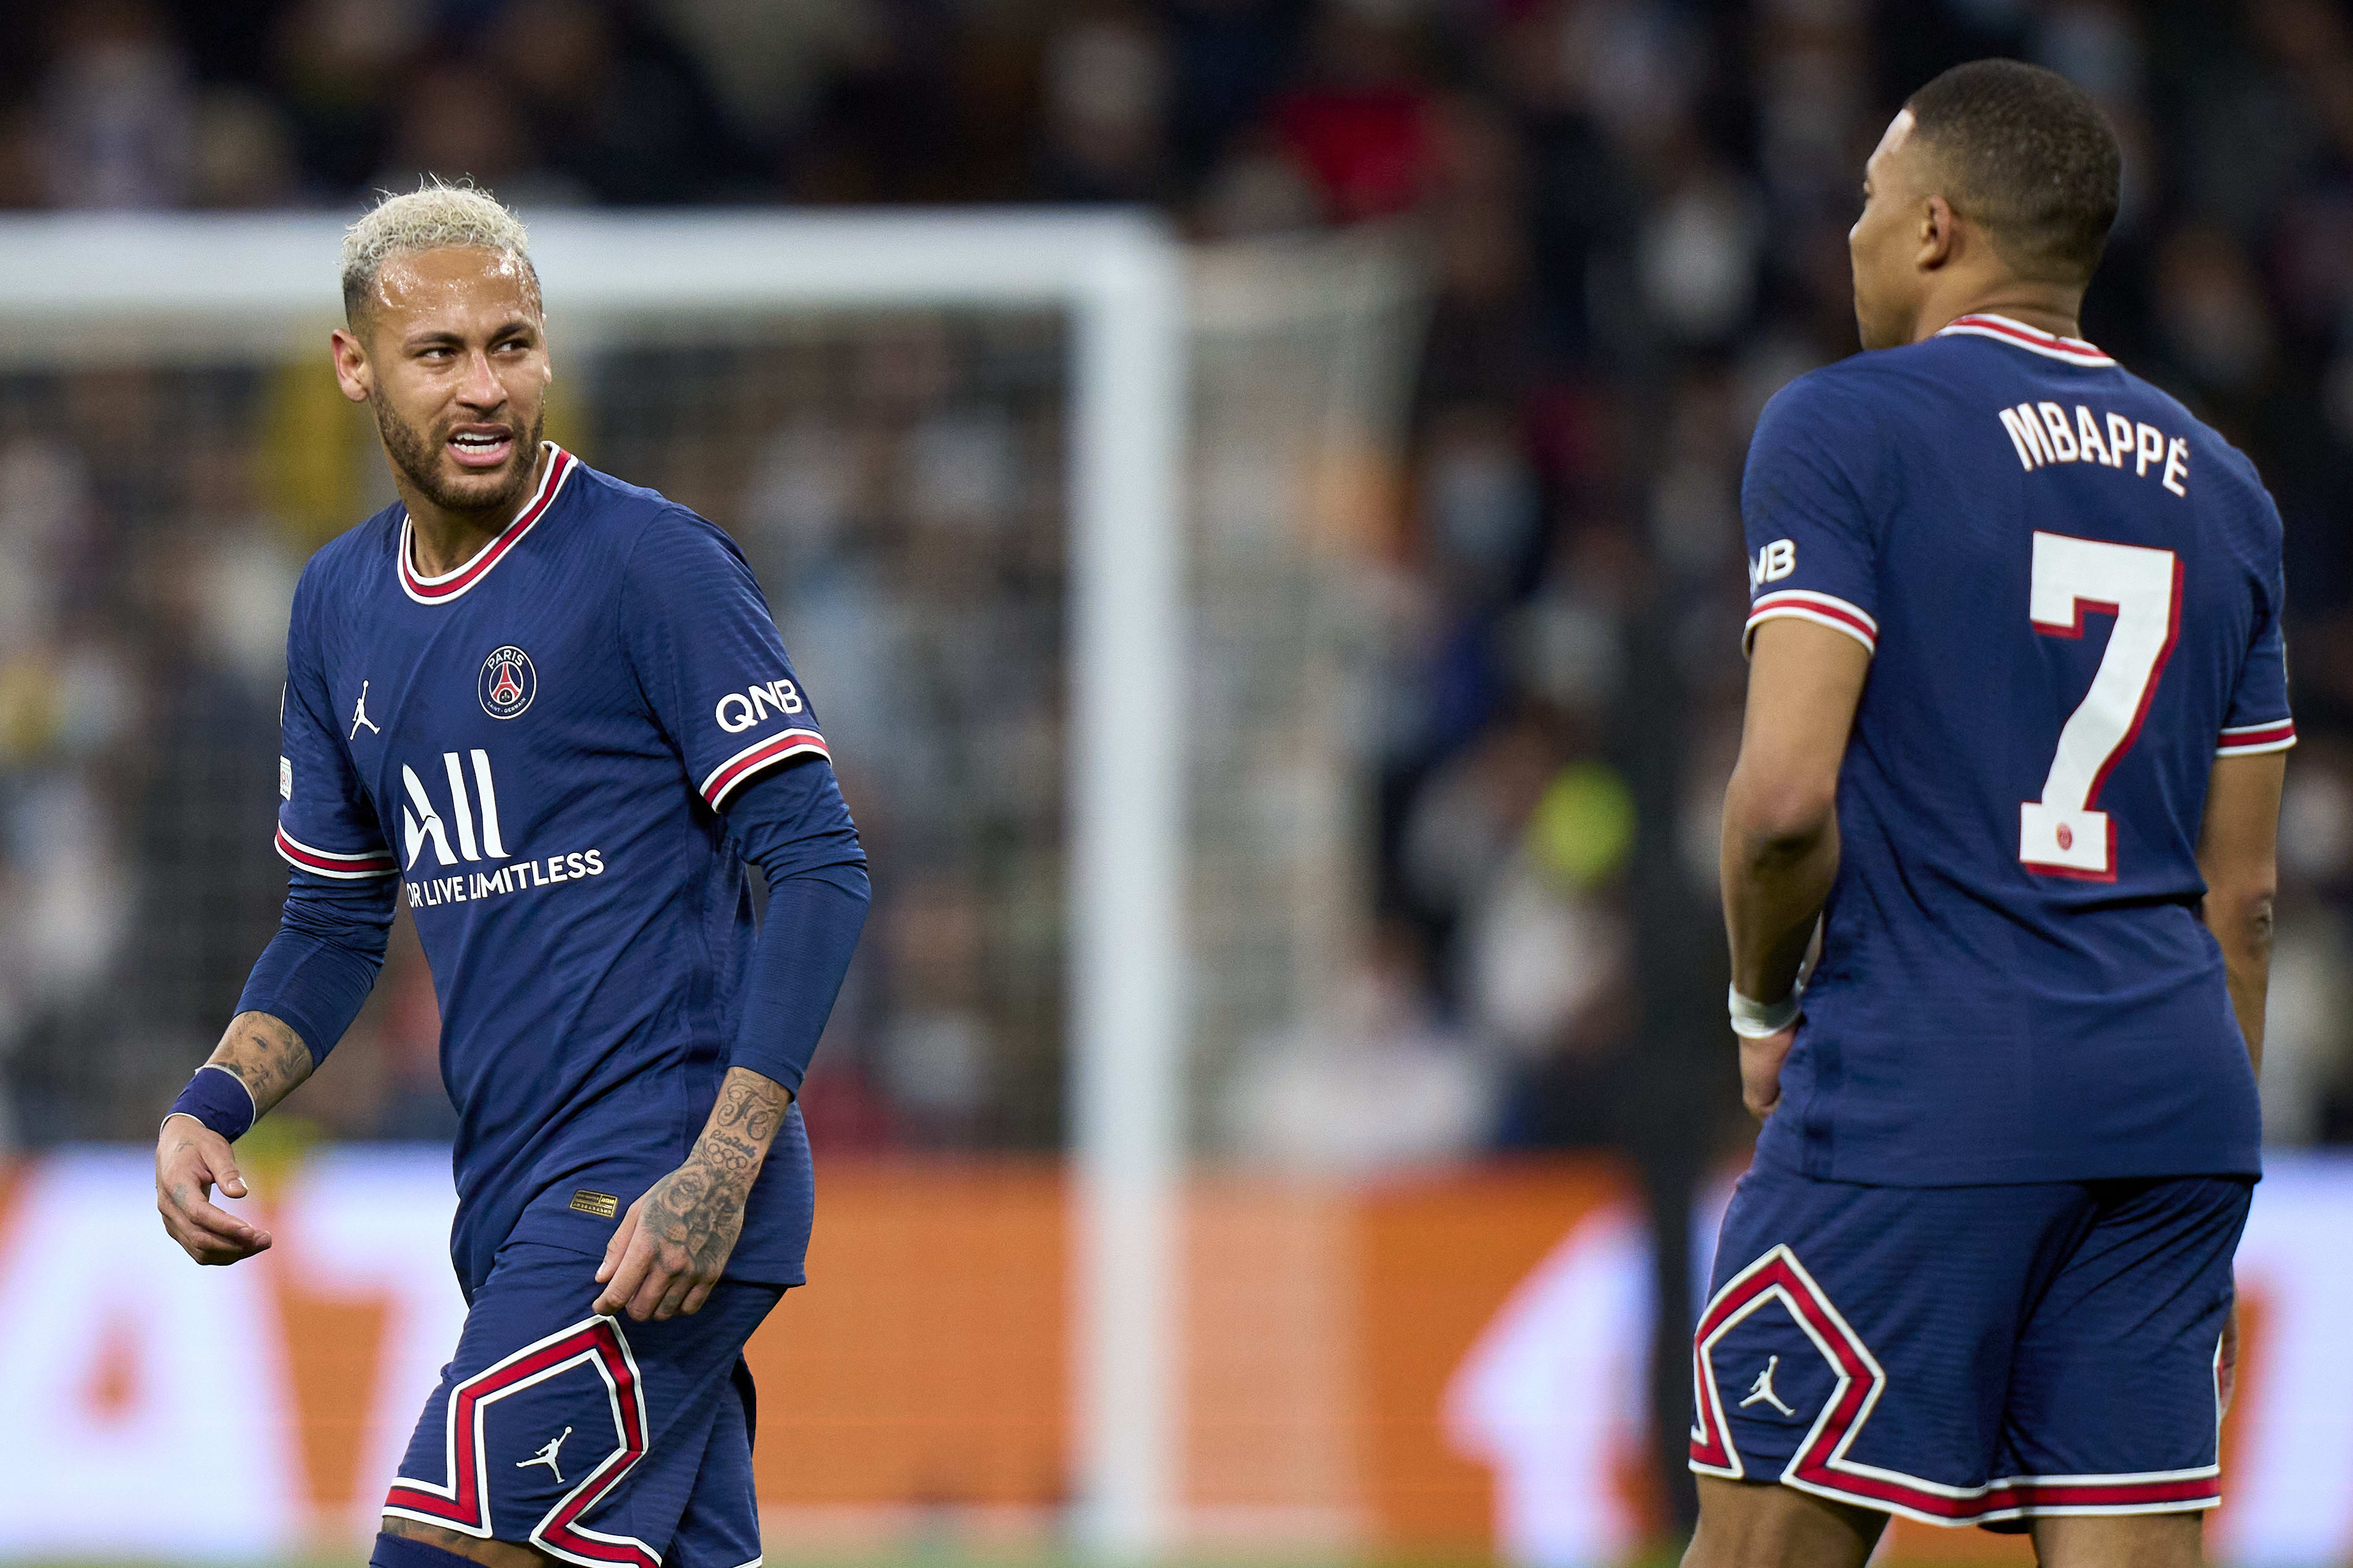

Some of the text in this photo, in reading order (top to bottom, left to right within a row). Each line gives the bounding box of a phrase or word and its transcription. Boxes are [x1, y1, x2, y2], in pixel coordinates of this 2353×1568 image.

[1998, 401, 2189, 498] MBAPPÉ
[487, 649, 524, 669] PARIS
[715, 679, 802, 733] QNB
[2019, 530, 2184, 883] 7
[423, 876, 467, 906] LIVE
[468, 849, 605, 899] LIMITLESS
